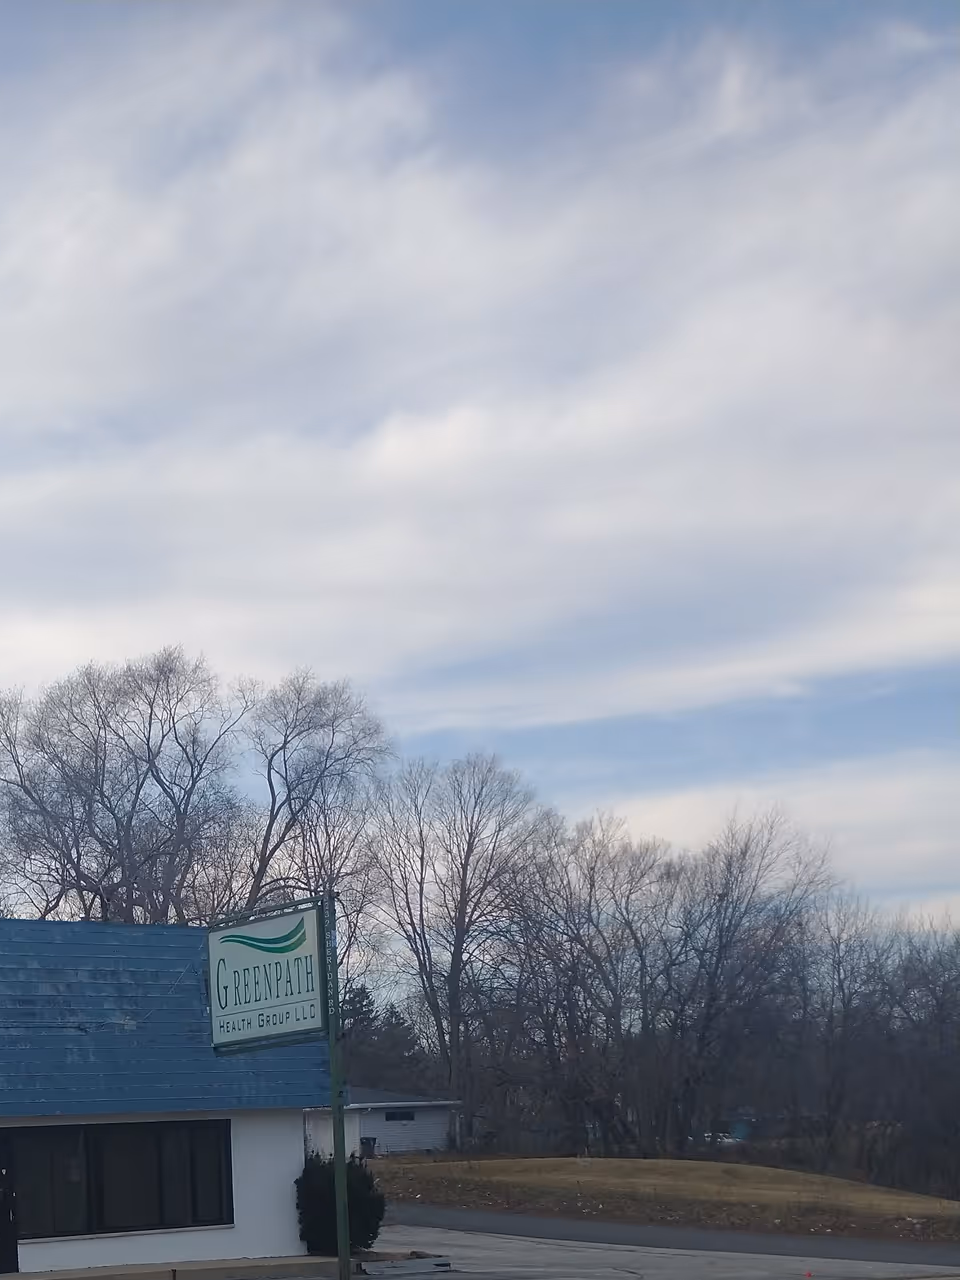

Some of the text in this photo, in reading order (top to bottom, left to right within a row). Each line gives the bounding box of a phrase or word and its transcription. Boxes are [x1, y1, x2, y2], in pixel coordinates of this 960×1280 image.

[216, 955, 315, 1010] GREENPATH
[325, 931, 334, 997] SHERIDAN
[219, 1004, 316, 1034] HEALTH GROUP LLC
